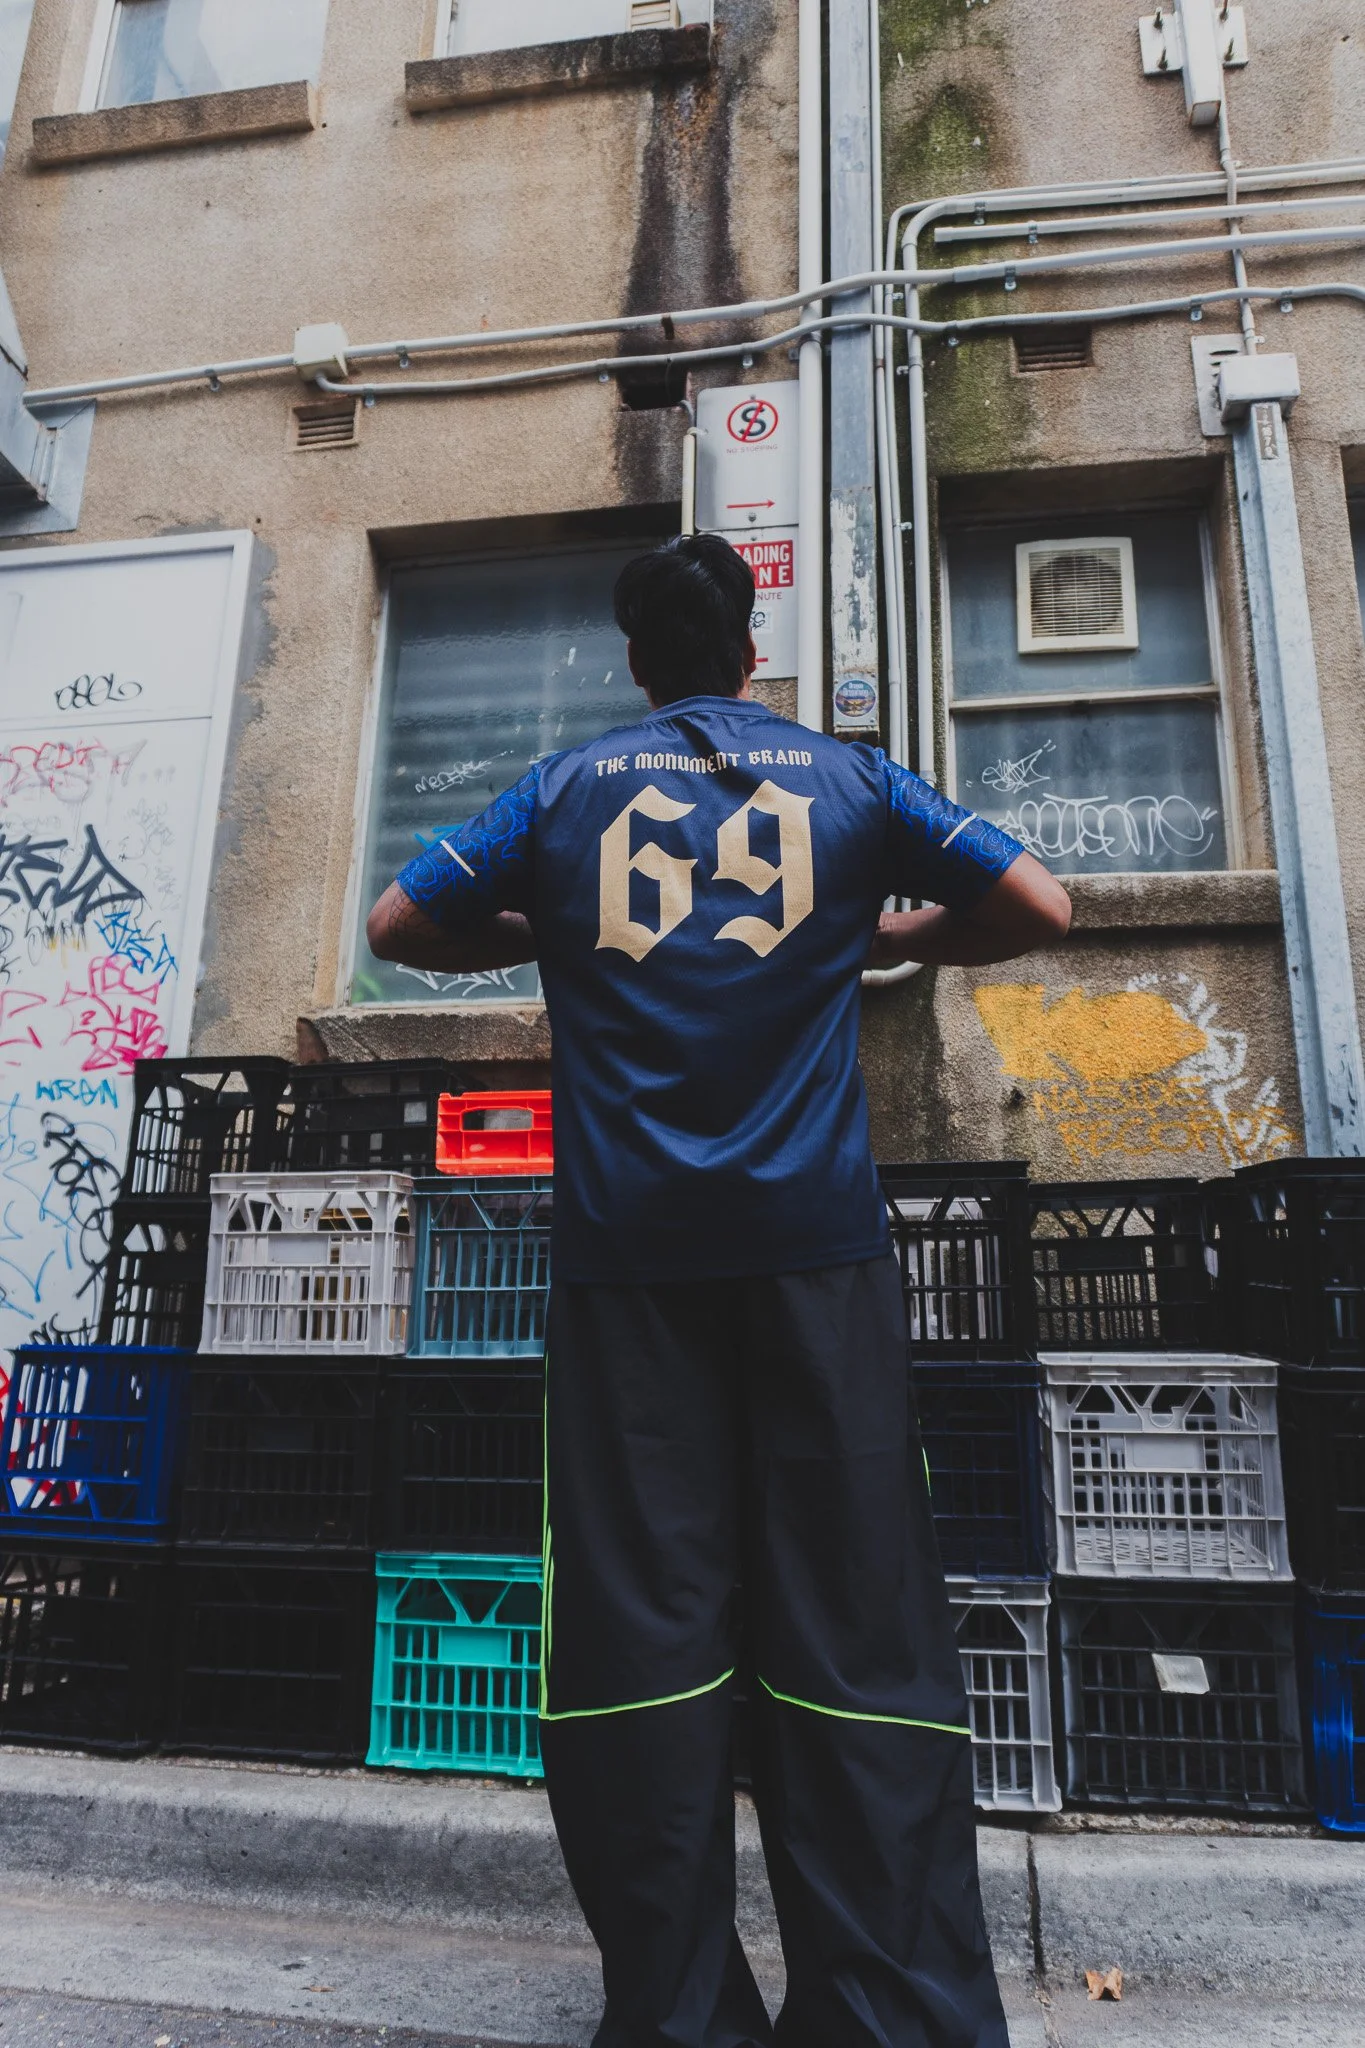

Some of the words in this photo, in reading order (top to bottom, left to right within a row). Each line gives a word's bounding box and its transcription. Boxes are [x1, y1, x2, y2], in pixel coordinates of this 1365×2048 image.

[734, 543, 790, 567] ADING
[758, 564, 790, 586] NE
[756, 591, 783, 601] NUTE
[595, 755, 629, 777] THE
[635, 752, 741, 774] MONUMENT
[748, 749, 813, 767] BRAND
[594, 779, 816, 963] 69
